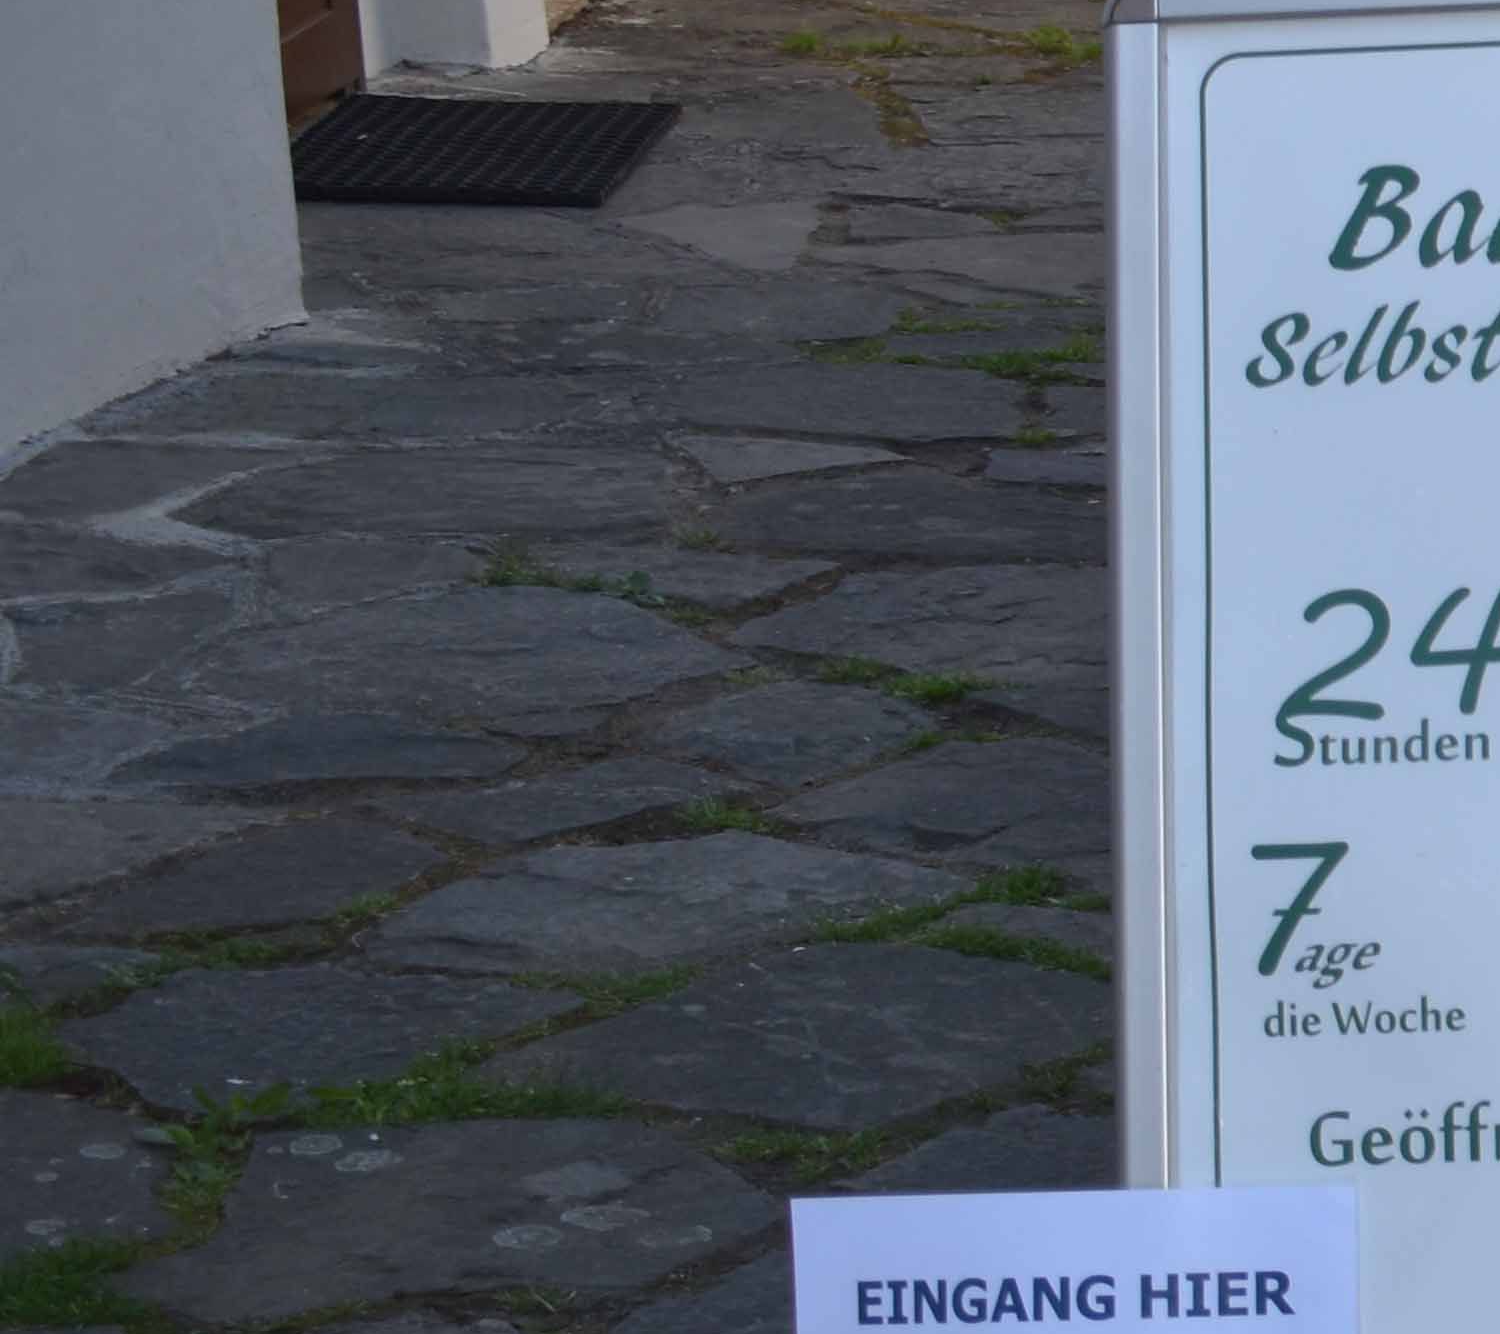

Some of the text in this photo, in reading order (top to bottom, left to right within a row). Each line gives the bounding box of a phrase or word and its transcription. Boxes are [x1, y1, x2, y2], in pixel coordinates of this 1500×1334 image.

[1273, 715, 1490, 768] Stunden
[1263, 994, 1467, 1038] die Woche
[856, 1270, 1297, 1326] EINGANG HIER
